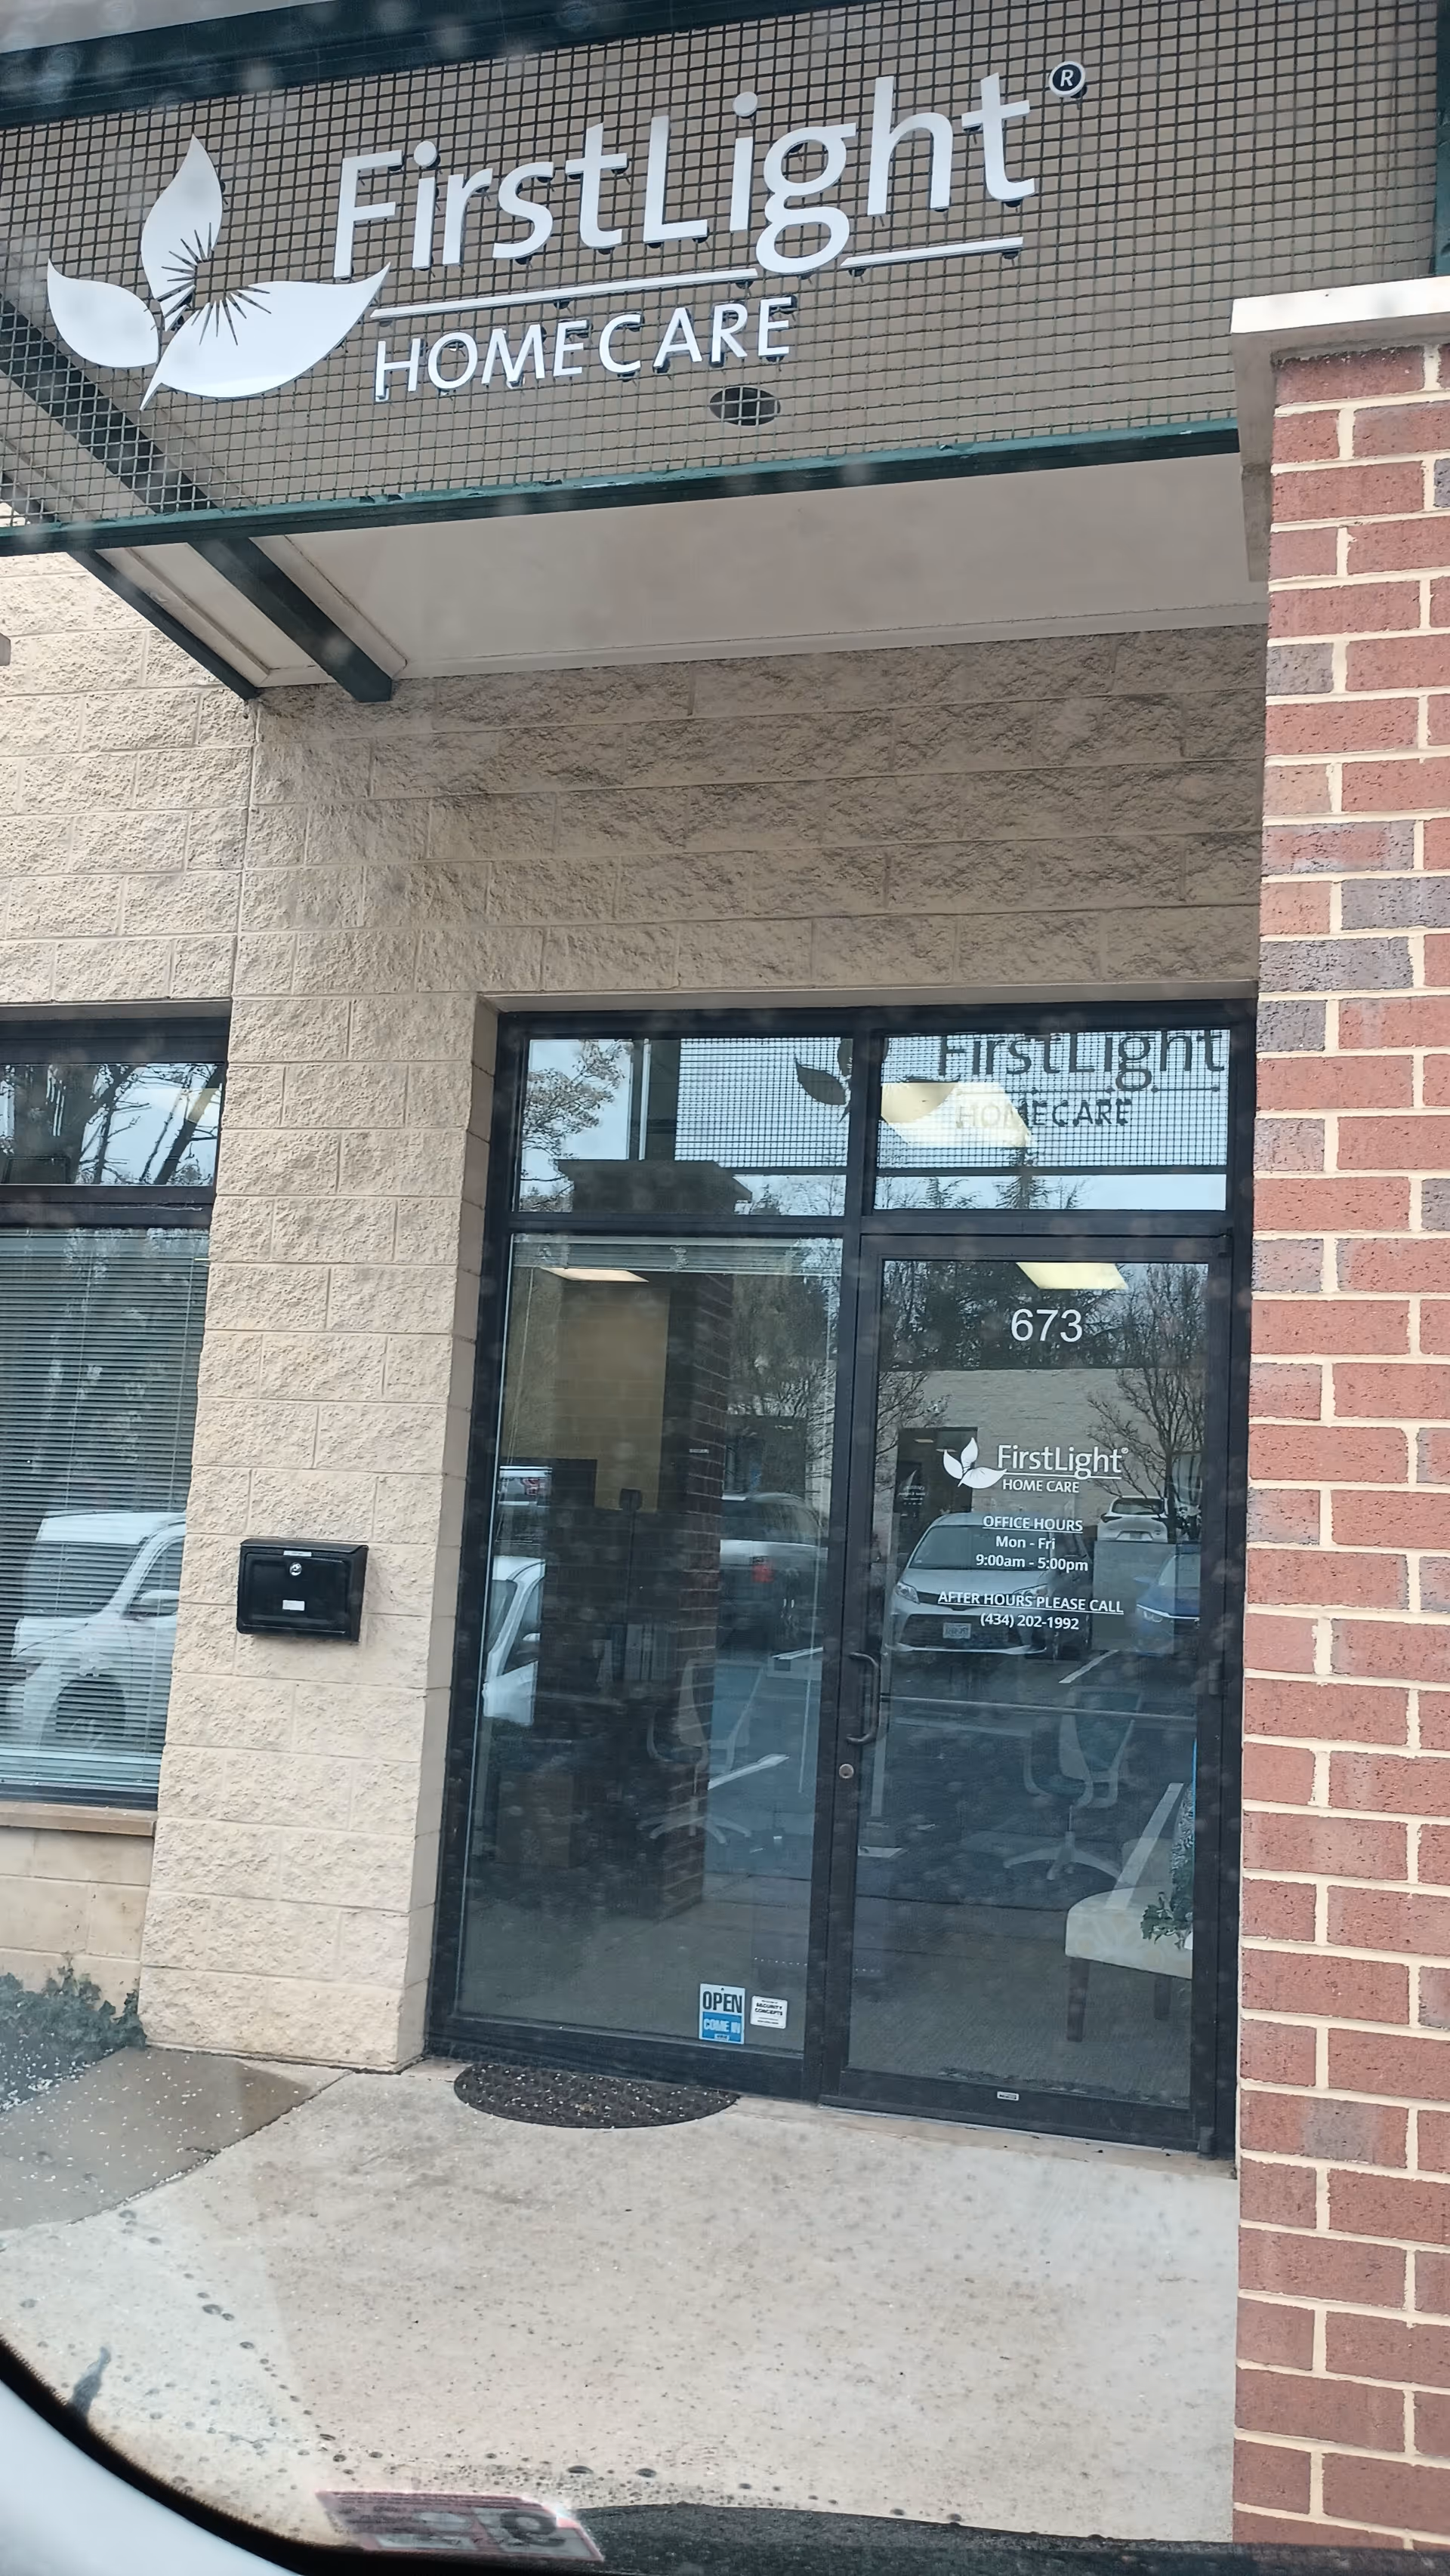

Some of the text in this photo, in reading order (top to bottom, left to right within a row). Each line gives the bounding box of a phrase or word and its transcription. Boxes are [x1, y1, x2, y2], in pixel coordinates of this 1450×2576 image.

[1010, 1308, 1083, 1342] 673
[1002, 1479, 1080, 1493] HOME CARE
[983, 1516, 1083, 1532] OFFICE HOURS
[995, 1536, 1026, 1548] Mon
[1038, 1537, 1056, 1549] Fri
[976, 1554, 1026, 1567] 9:00am
[1038, 1558, 1088, 1573] 5:00pm
[938, 1592, 1124, 1613] AFTER HOURS PLEASE CALL
[980, 1613, 1079, 1630] (434) 202-1992
[702, 1991, 742, 2014] OPEN
[704, 2018, 730, 2032] COME
